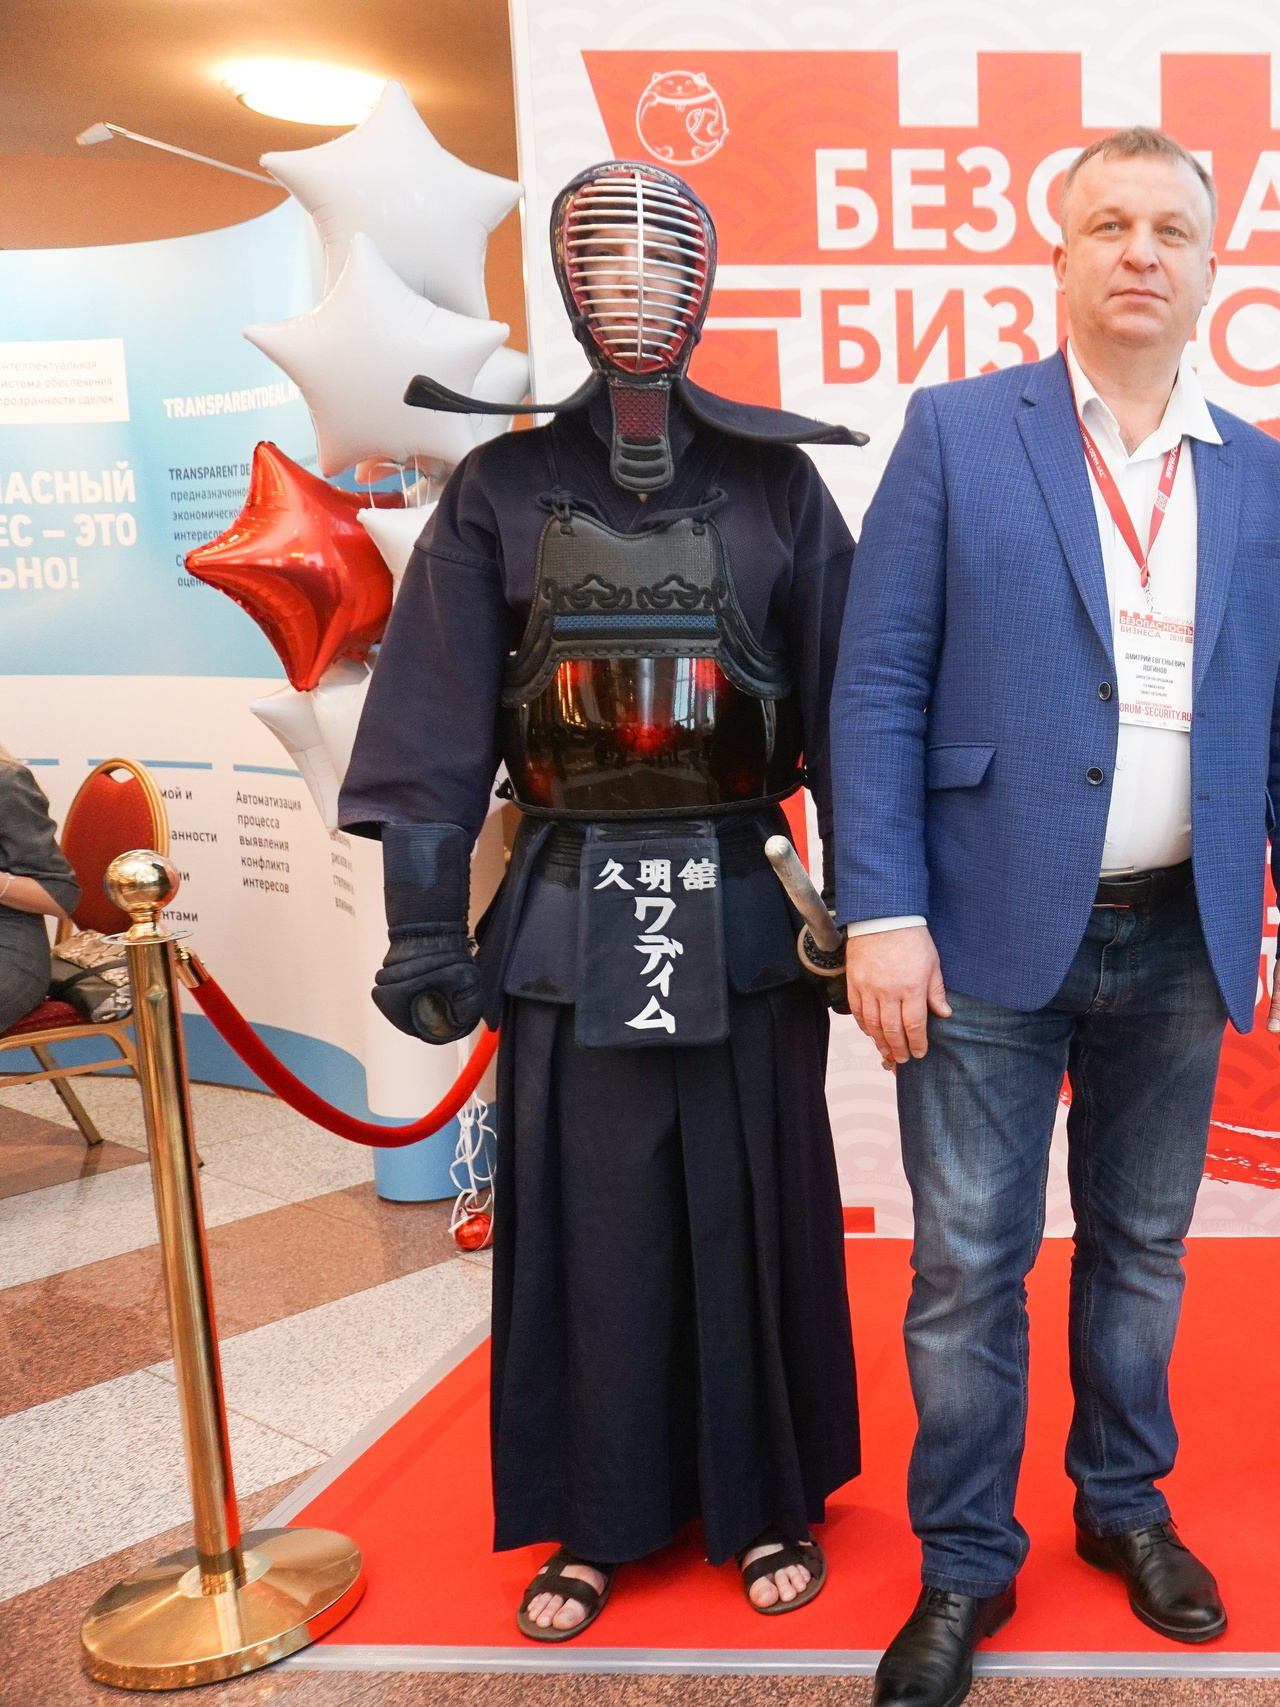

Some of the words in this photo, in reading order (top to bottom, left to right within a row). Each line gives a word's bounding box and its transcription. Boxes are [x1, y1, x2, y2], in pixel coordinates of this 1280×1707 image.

[0, 361, 97, 372] нтеллектуальная
[169, 464, 238, 480] TRANSPARENT
[0, 460, 136, 504] АСНЫЙ
[73, 512, 137, 547] ЭТО
[1120, 616, 1193, 636] БЕЗОПАСНОСТЬ
[1120, 625, 1161, 639] БИЗНЕСА
[1119, 702, 1192, 722] ORUM-SECURITY.RU
[236, 790, 301, 811] Автоматизация
[238, 814, 280, 829] процесса
[239, 836, 289, 851] выявления
[241, 855, 290, 873] конфликта
[243, 877, 289, 894] интересов
